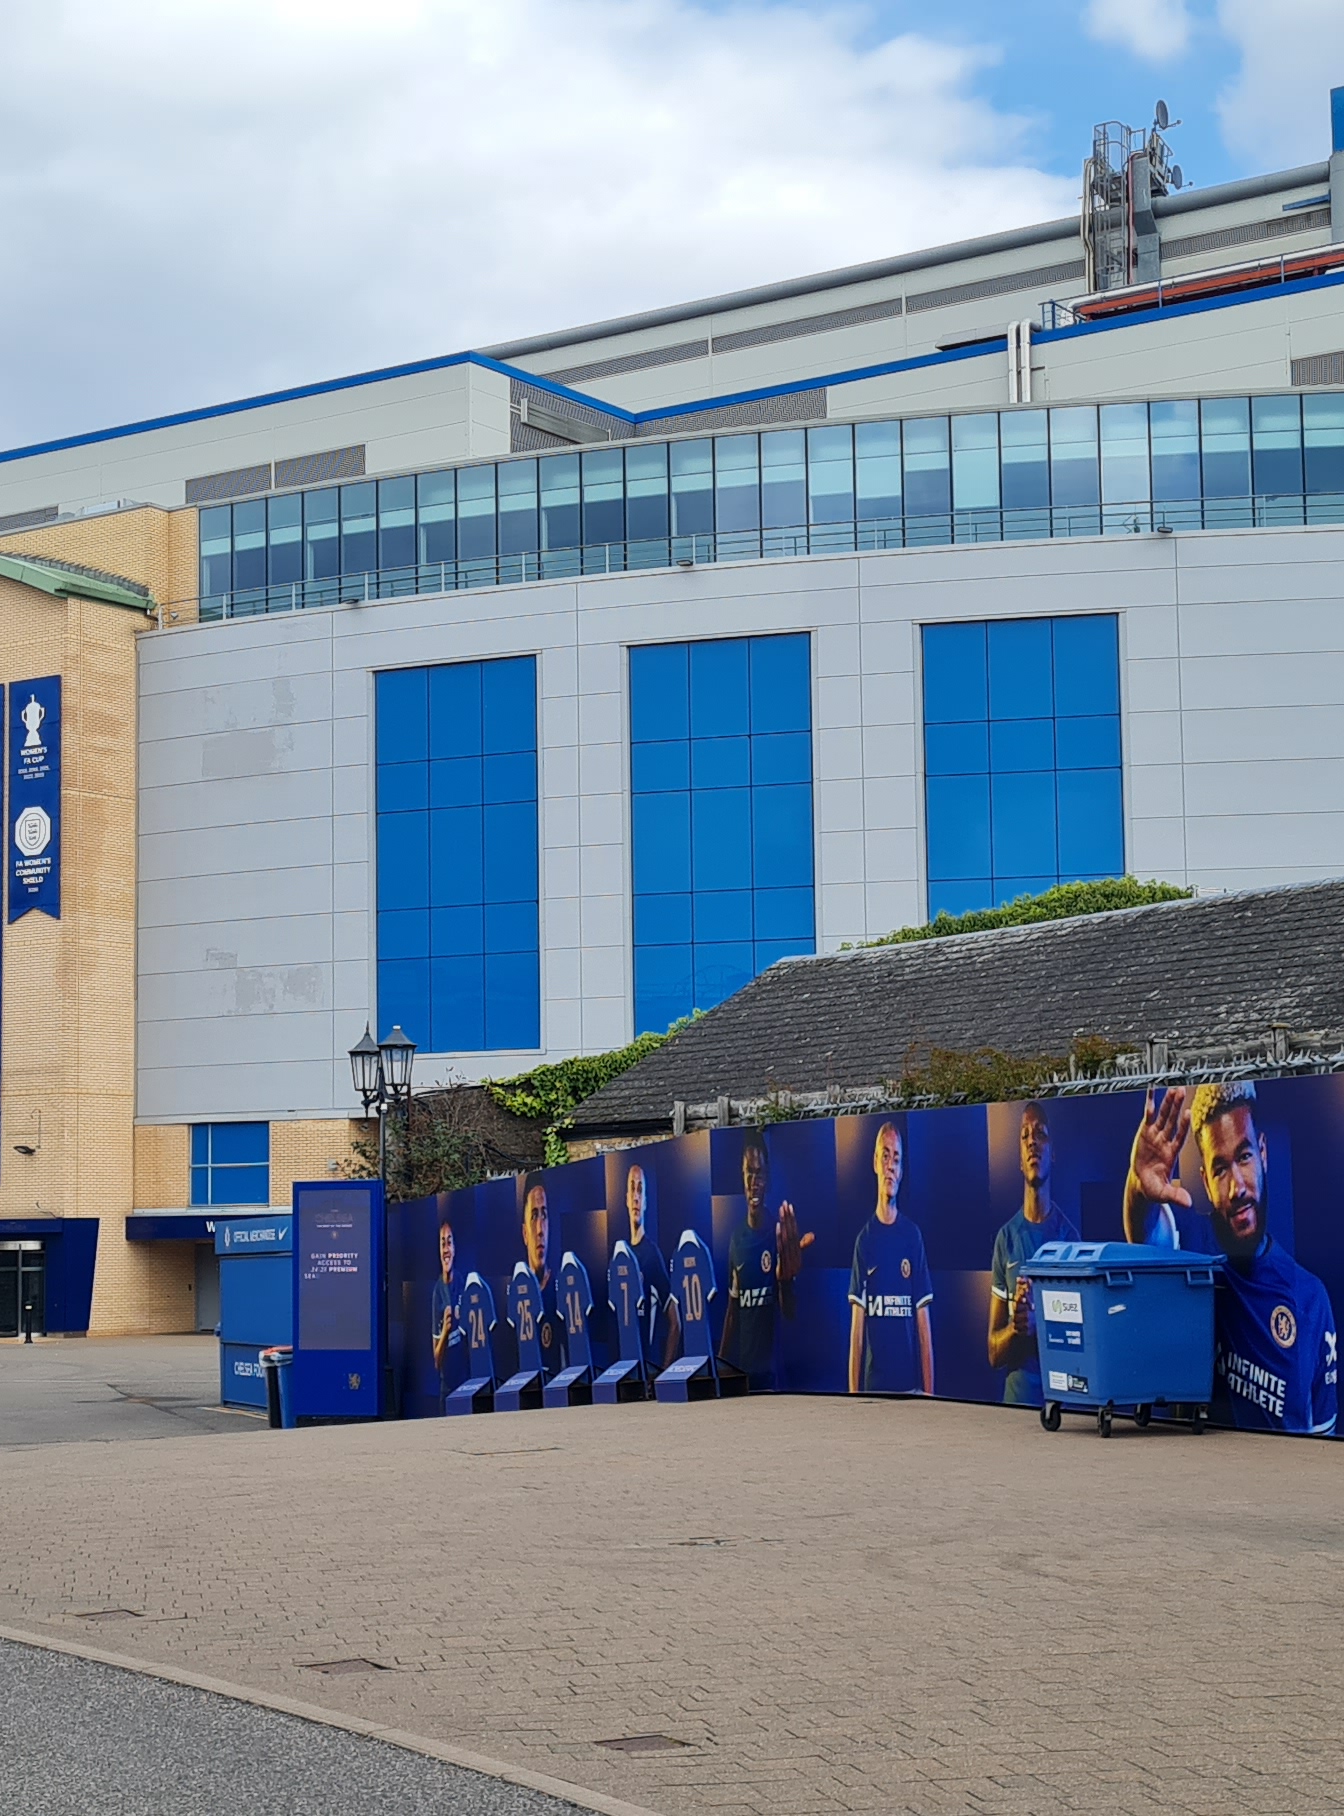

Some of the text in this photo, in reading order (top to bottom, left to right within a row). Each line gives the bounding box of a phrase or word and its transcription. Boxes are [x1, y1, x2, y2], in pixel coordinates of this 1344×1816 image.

[565, 1291, 583, 1334] 14
[620, 1282, 629, 1326] 7
[682, 1273, 702, 1322] 10
[883, 1295, 912, 1306] INFINITE
[883, 1306, 913, 1317] ATHLETE
[1062, 1302, 1078, 1313] SUEZ
[468, 1309, 486, 1349] 24
[517, 1300, 534, 1341] 25
[1227, 1351, 1287, 1399] INFINITE
[1227, 1372, 1286, 1418] ATHLETE
